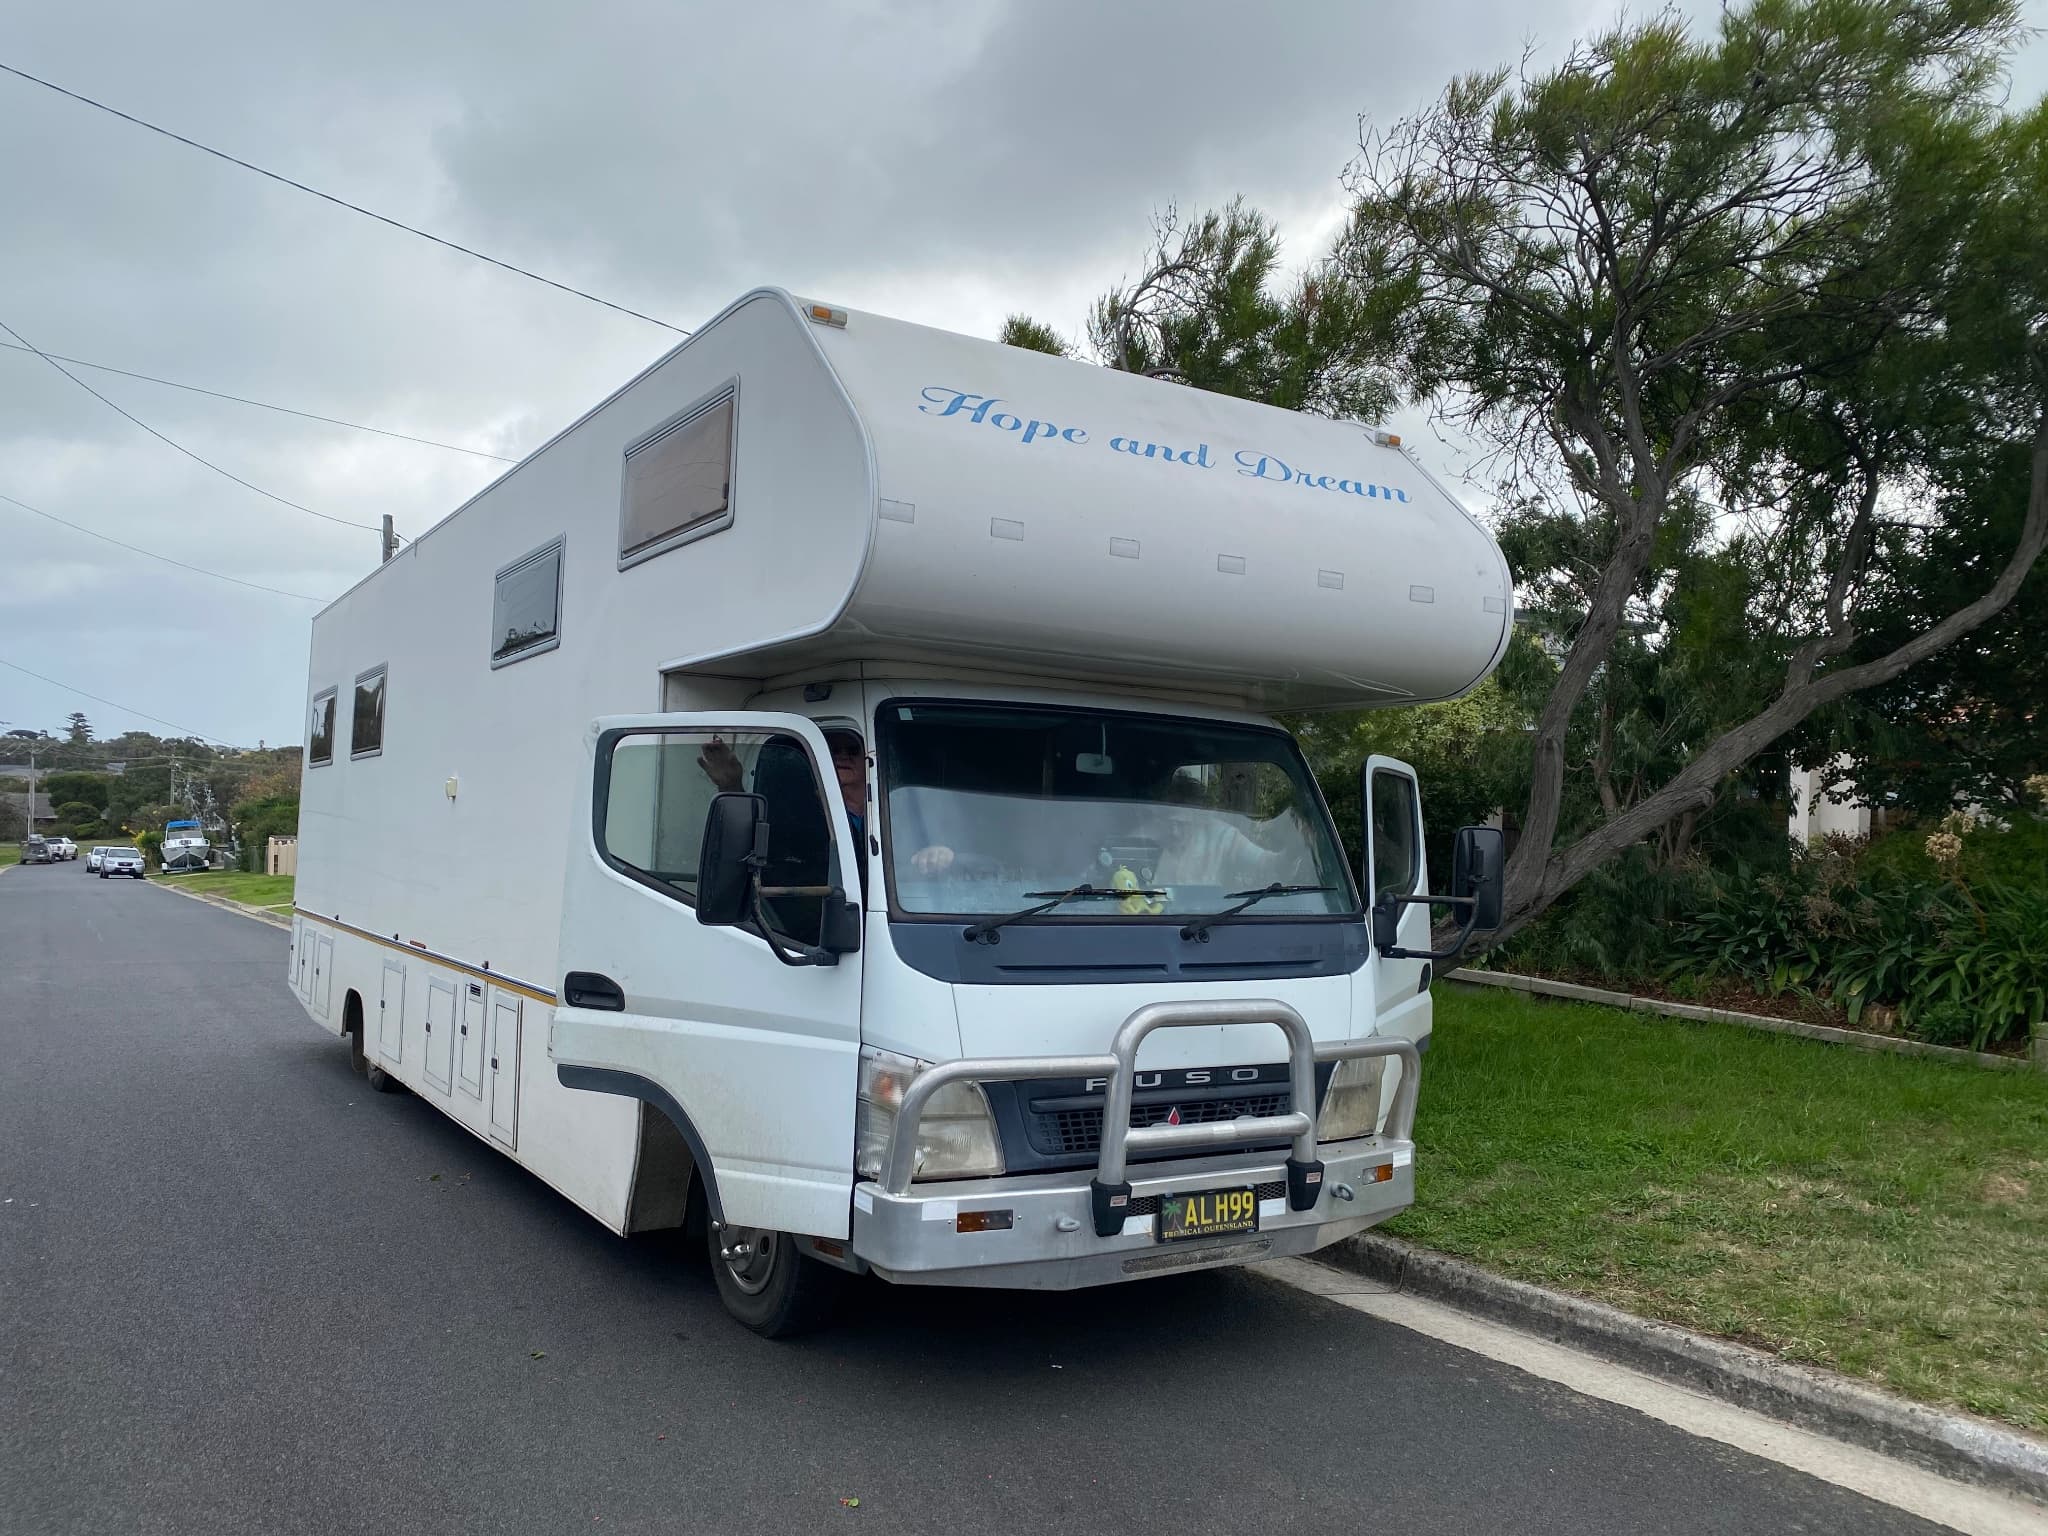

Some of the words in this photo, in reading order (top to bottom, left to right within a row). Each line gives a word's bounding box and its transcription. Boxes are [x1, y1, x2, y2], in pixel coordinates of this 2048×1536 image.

[919, 386, 1090, 443] Hope
[1109, 436, 1216, 468] and
[1233, 449, 1413, 504] Dream
[1085, 1068, 1259, 1091] FUSO
[1163, 1227, 1201, 1239] TROICAL
[1203, 1220, 1254, 1233] QUEENSLAND
